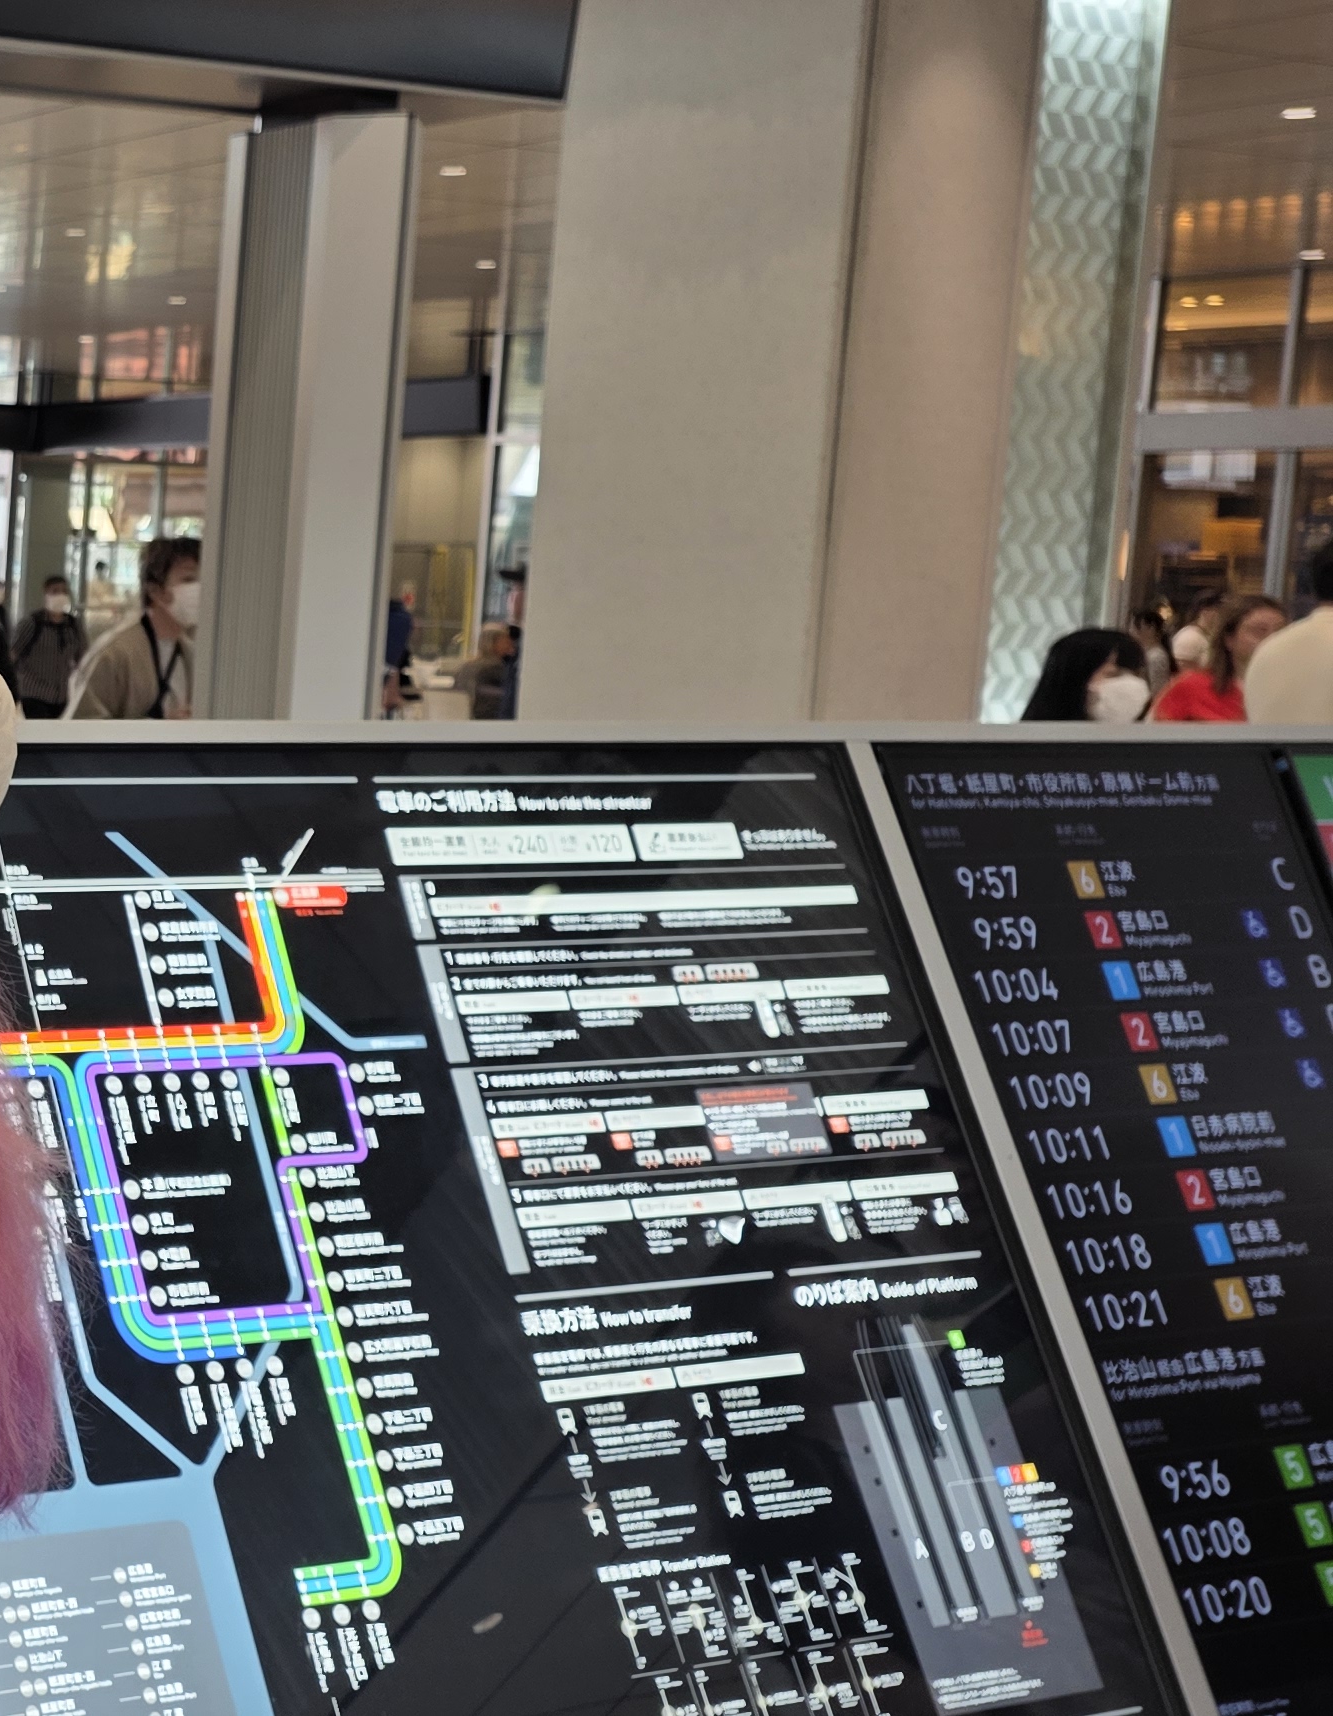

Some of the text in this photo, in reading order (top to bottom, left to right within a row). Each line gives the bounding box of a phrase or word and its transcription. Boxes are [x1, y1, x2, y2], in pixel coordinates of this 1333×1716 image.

[376, 789, 517, 813] 電車のご利用方法
[957, 866, 1018, 899] 9:57
[1081, 866, 1095, 894] 6
[1271, 857, 1295, 891] C
[974, 916, 1037, 950] 9:59
[1095, 915, 1114, 944] 2
[1117, 909, 1169, 932] 宮島口
[1289, 905, 1313, 939] D
[974, 968, 1059, 1003] 10:04
[1114, 966, 1128, 995] 1
[1136, 959, 1187, 982] 広島港
[1307, 954, 1332, 989] B
[991, 1019, 1071, 1056] 10:07
[1132, 1018, 1151, 1046] 2
[1153, 1010, 1206, 1034] 宮島口
[1010, 1071, 1092, 1110] 10:09
[1151, 1069, 1169, 1099] 6
[1028, 1124, 1111, 1164] 10:11
[1169, 1122, 1183, 1152] 1
[1189, 1175, 1206, 1206] 2
[1209, 1166, 1263, 1190] 宮島口
[1047, 1179, 1133, 1220] 10:16
[1208, 1228, 1223, 1260] 1
[1230, 1219, 1282, 1244] 広島港
[1066, 1234, 1152, 1276] 10:18
[794, 1278, 879, 1308] のりば案内
[880, 1282, 914, 1298] Guide
[928, 1275, 978, 1293] Platform
[1227, 1284, 1246, 1315] 6
[1085, 1289, 1168, 1332] 10:21
[933, 1409, 948, 1431] C
[1160, 1459, 1231, 1502] 9:56
[1283, 1450, 1305, 1484] 5
[960, 1526, 994, 1552] B D
[1304, 1508, 1325, 1541] 5
[915, 1537, 929, 1560] A
[1163, 1516, 1251, 1565] 10:08
[1183, 1575, 1272, 1626] 10:20
